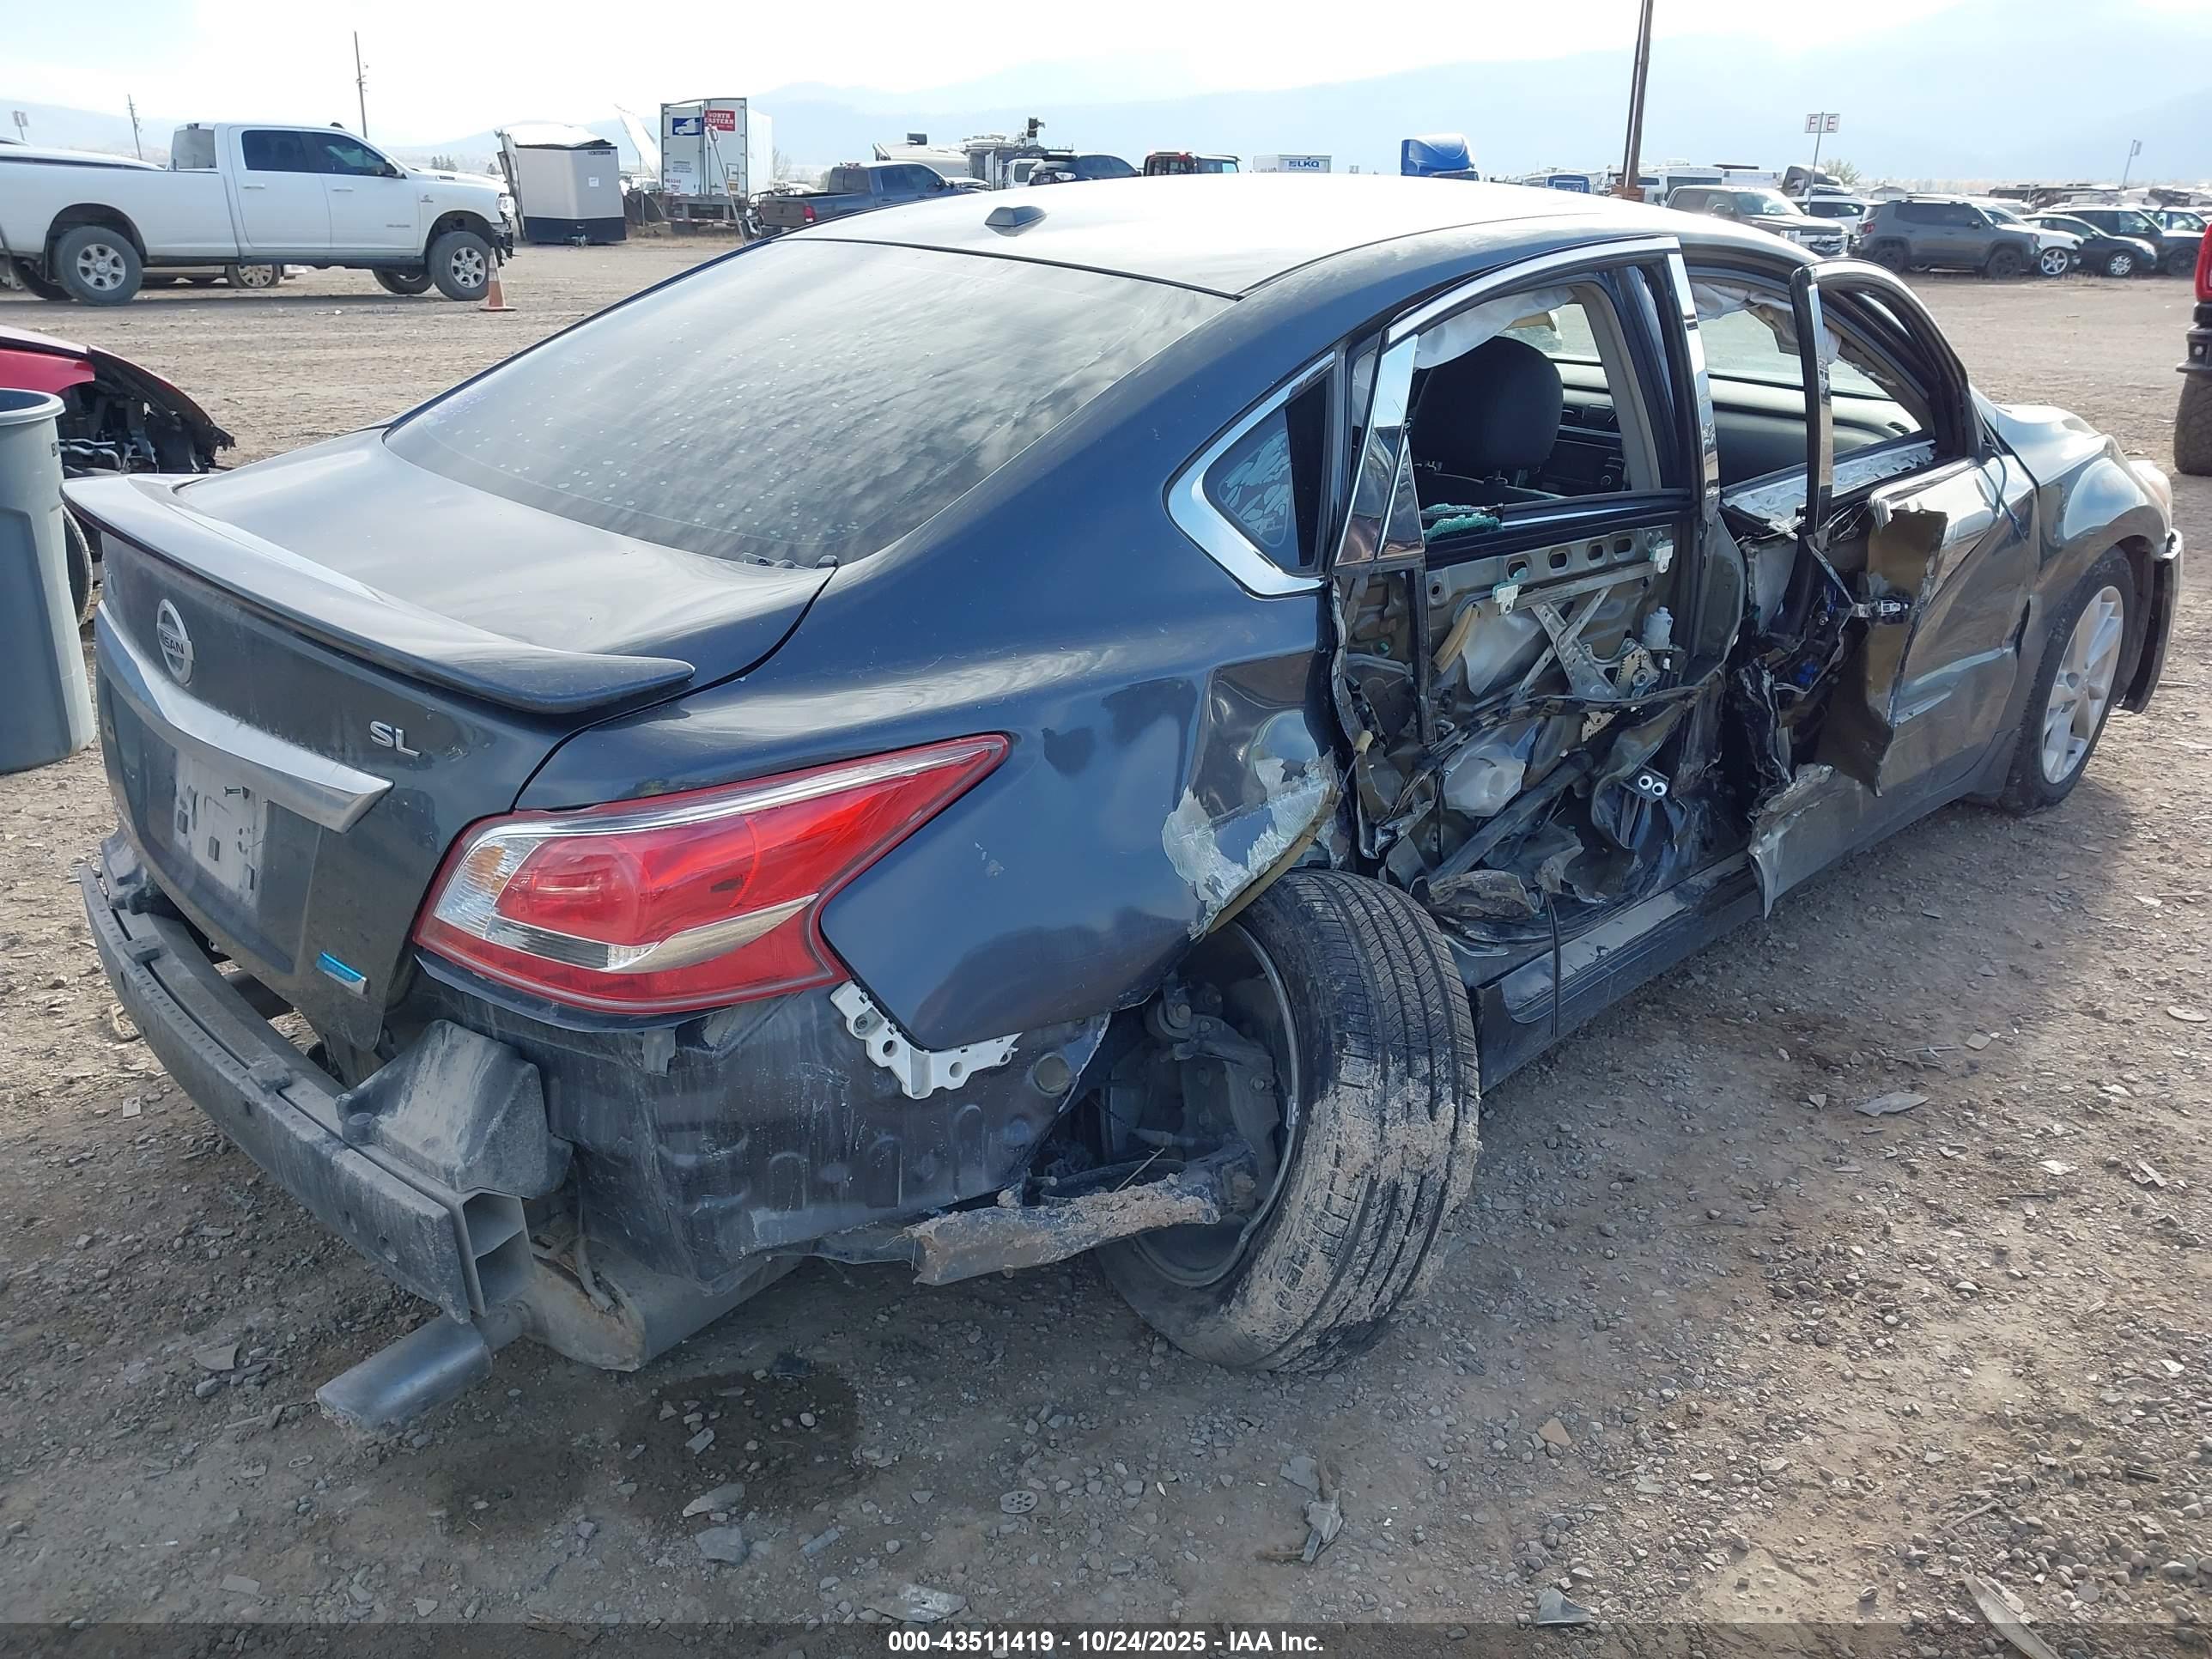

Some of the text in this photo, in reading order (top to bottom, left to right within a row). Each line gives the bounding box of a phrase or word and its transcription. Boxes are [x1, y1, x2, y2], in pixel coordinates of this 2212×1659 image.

[1808, 116, 1818, 131] F
[1826, 116, 1837, 131] E
[370, 721, 421, 757] SL
